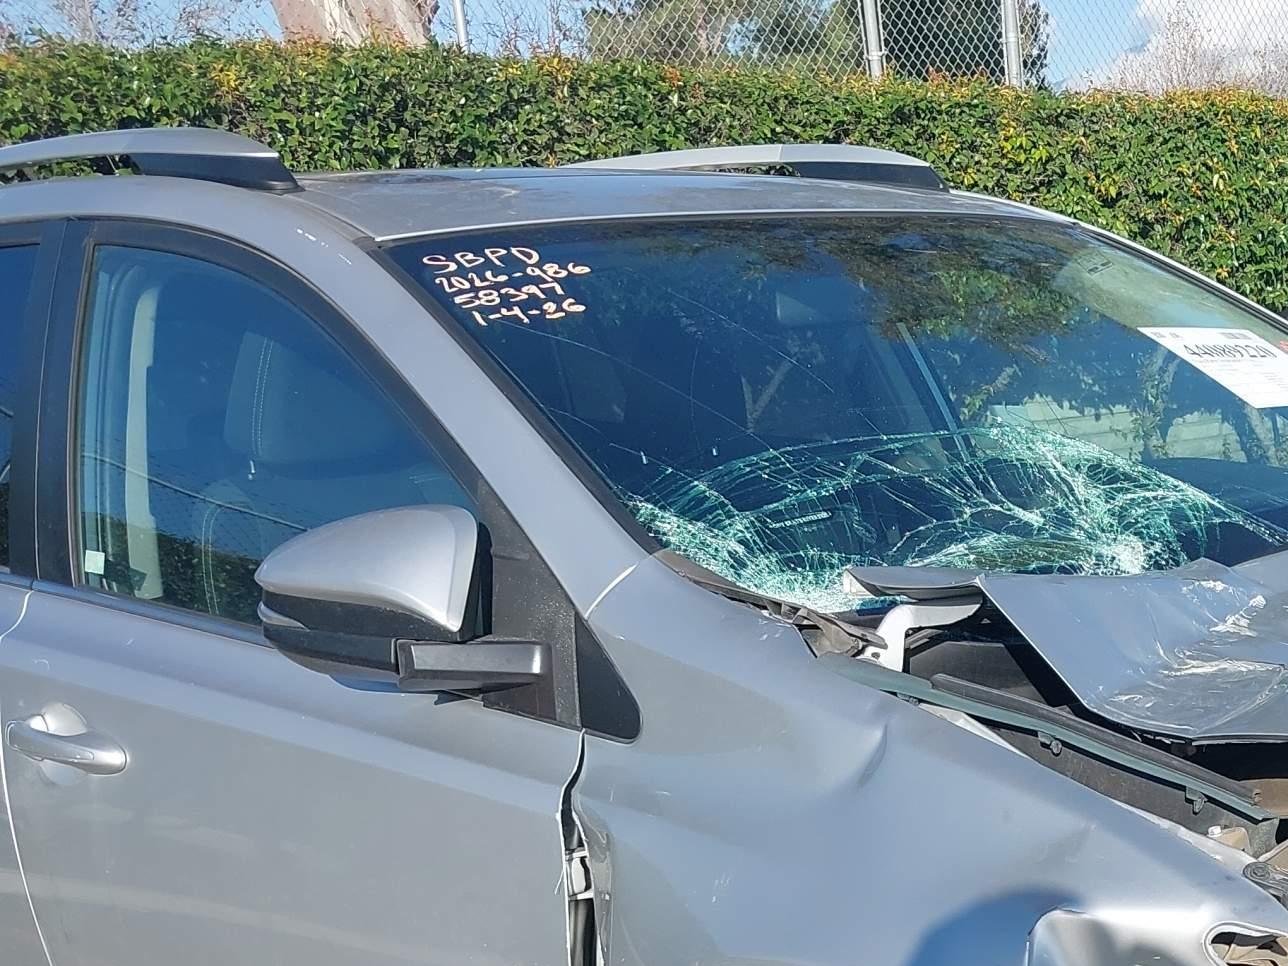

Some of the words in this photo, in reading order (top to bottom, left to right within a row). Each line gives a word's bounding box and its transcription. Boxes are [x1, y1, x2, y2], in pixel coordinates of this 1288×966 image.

[422, 247, 540, 274] SBPD
[434, 262, 592, 293] 2026-986
[453, 281, 566, 309] 58397
[471, 297, 587, 327] 1-4-26
